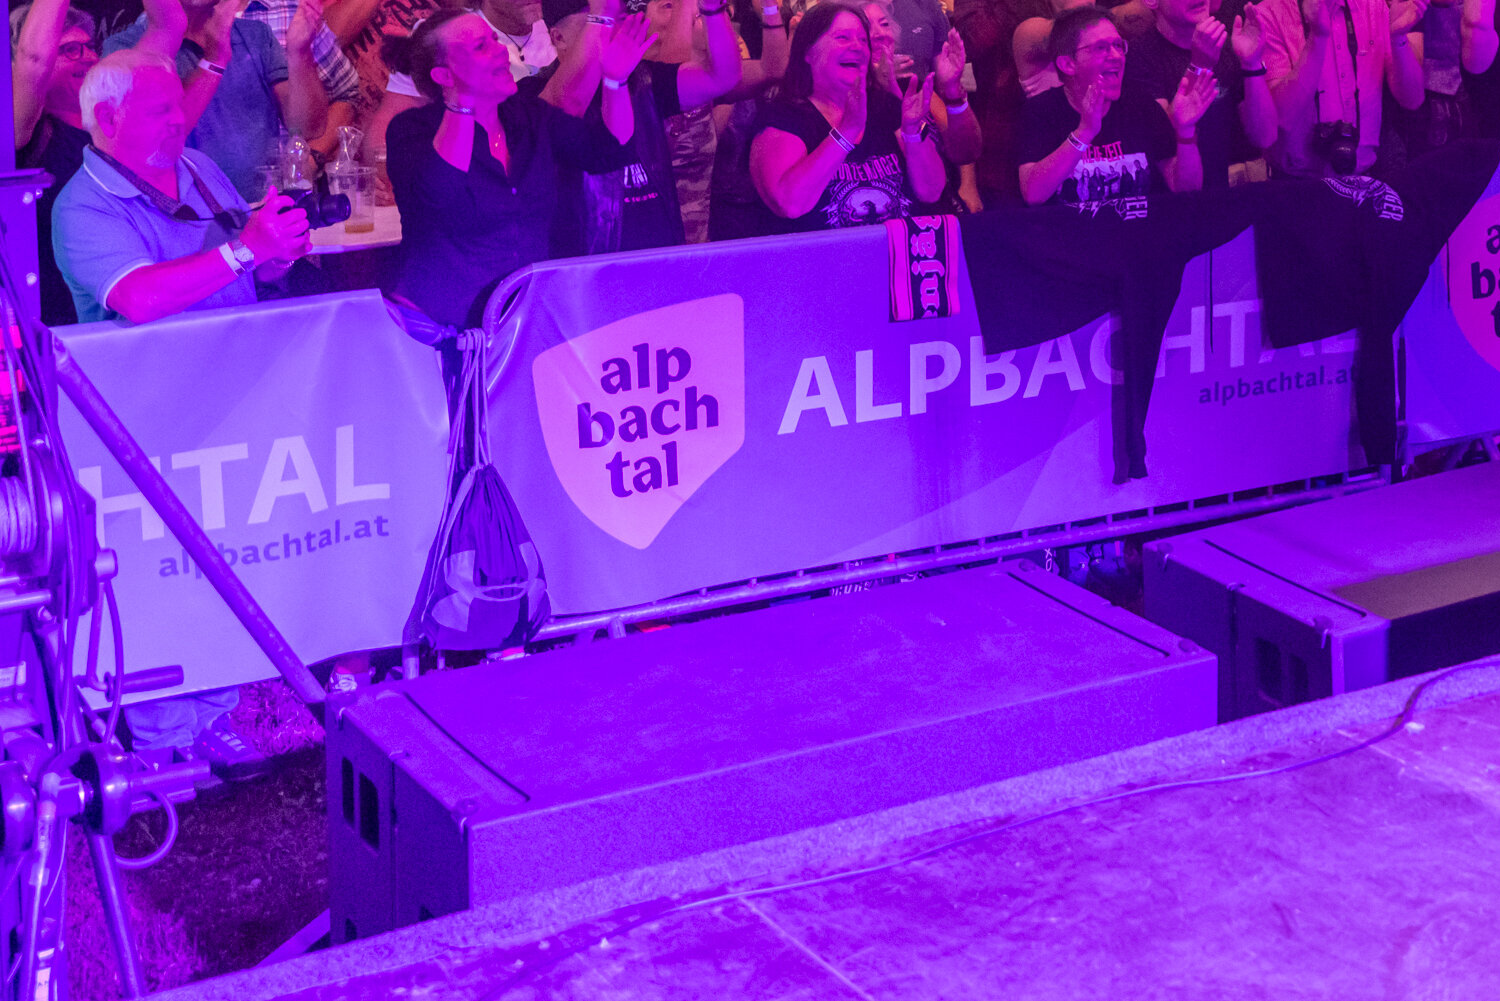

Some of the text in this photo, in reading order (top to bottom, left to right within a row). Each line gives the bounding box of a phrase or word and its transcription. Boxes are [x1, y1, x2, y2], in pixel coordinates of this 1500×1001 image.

[600, 342, 692, 399] alp
[577, 386, 719, 449] bach
[606, 441, 679, 498] tal
